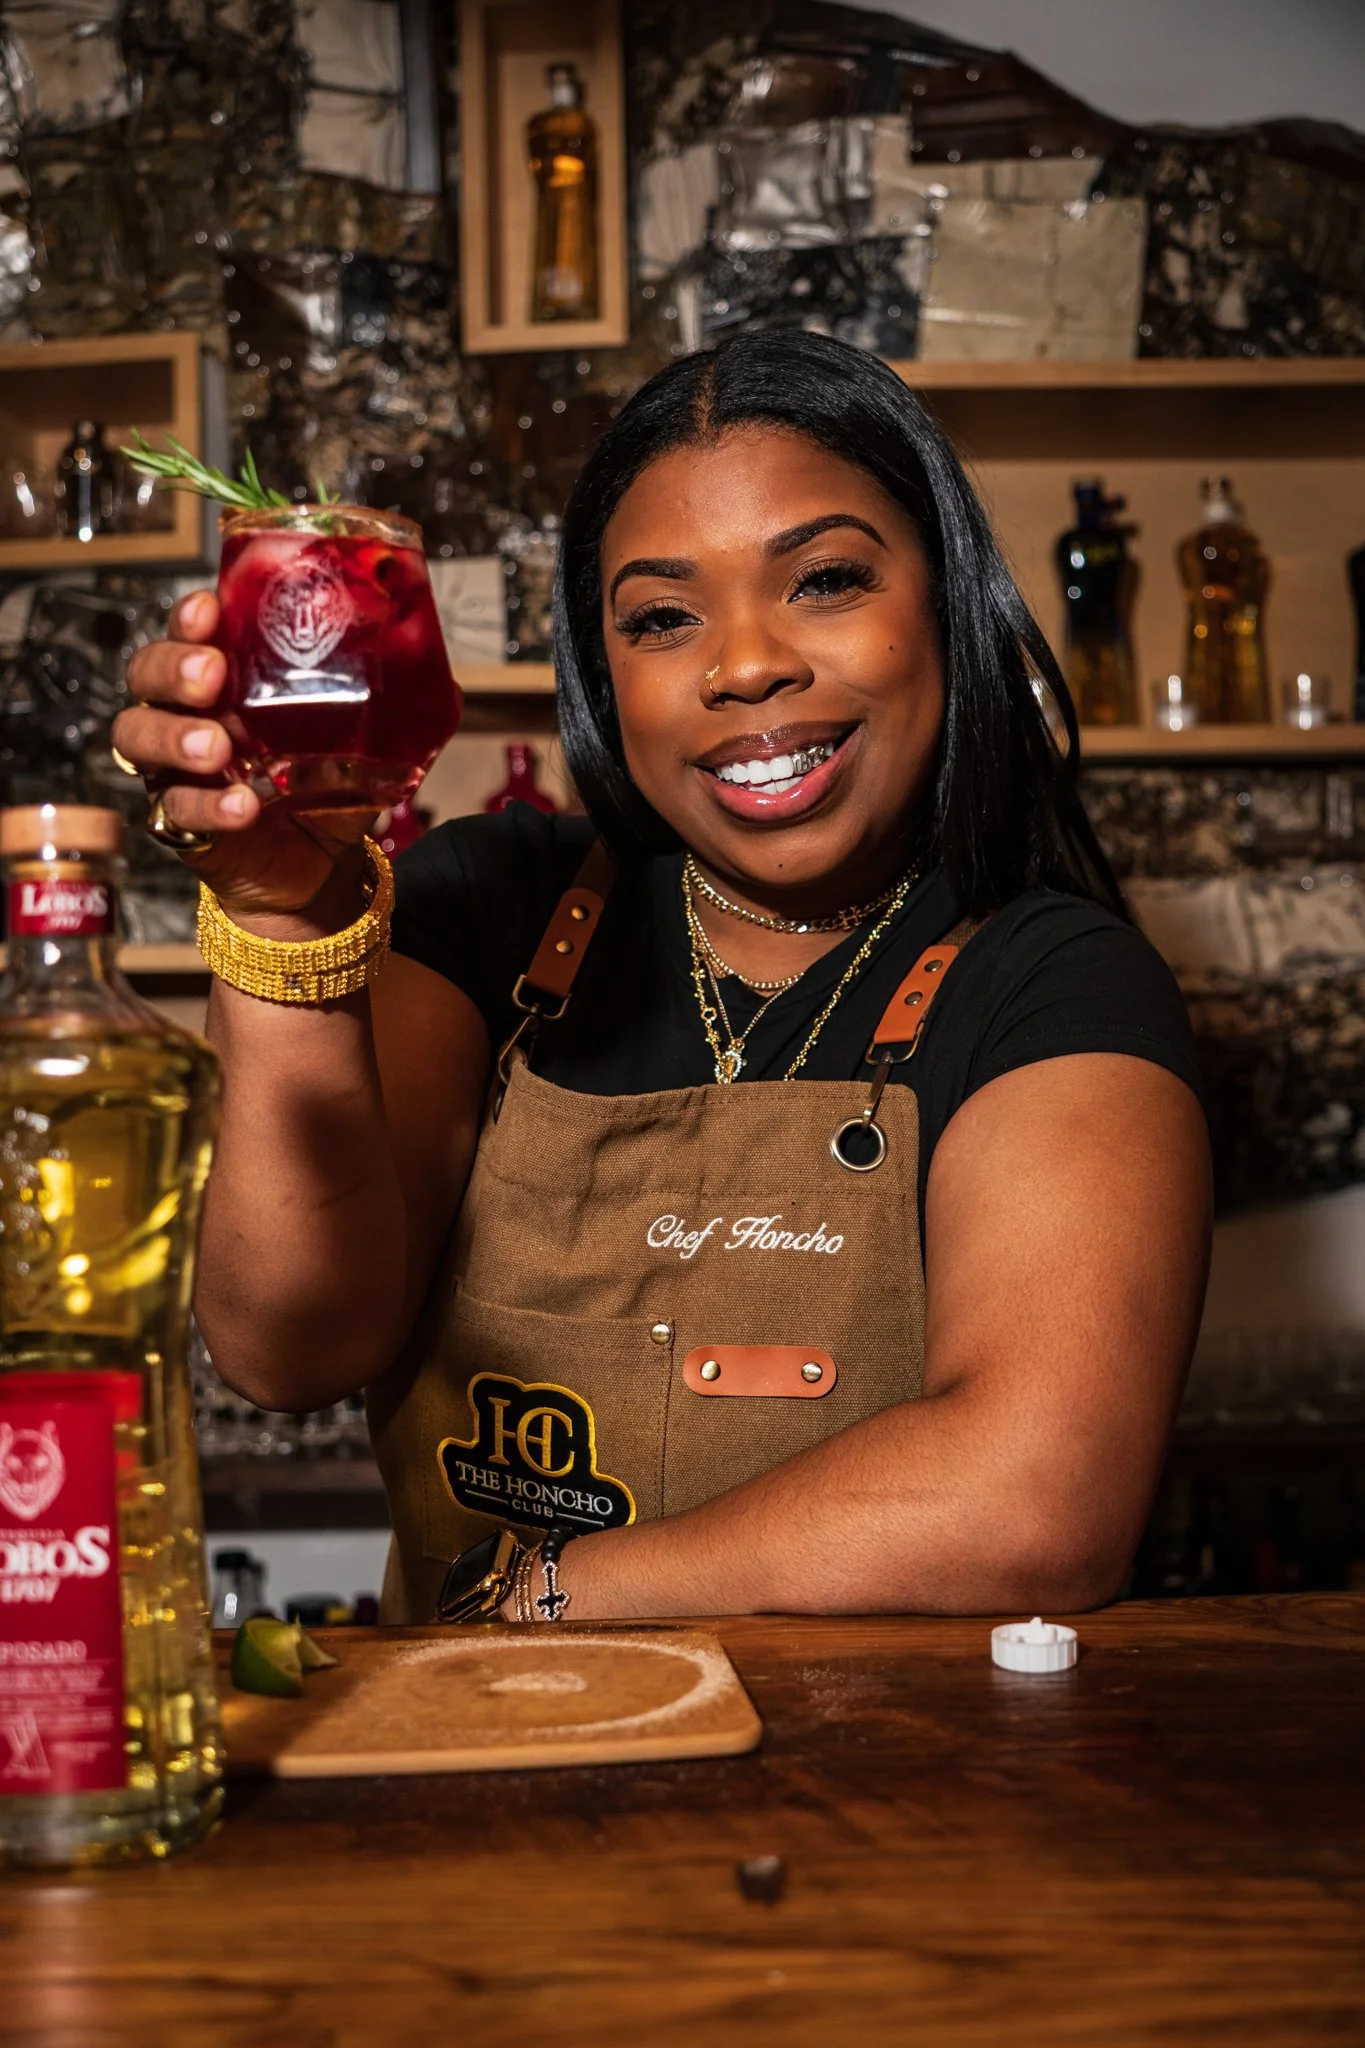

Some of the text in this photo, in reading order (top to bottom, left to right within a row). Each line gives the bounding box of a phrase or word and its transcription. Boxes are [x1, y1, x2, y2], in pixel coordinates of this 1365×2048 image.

[22, 884, 108, 917] LOBOS
[647, 1214, 845, 1260] Chef Honcho
[455, 1460, 613, 1517] THE HONCHO
[512, 1499, 554, 1519] CLUB
